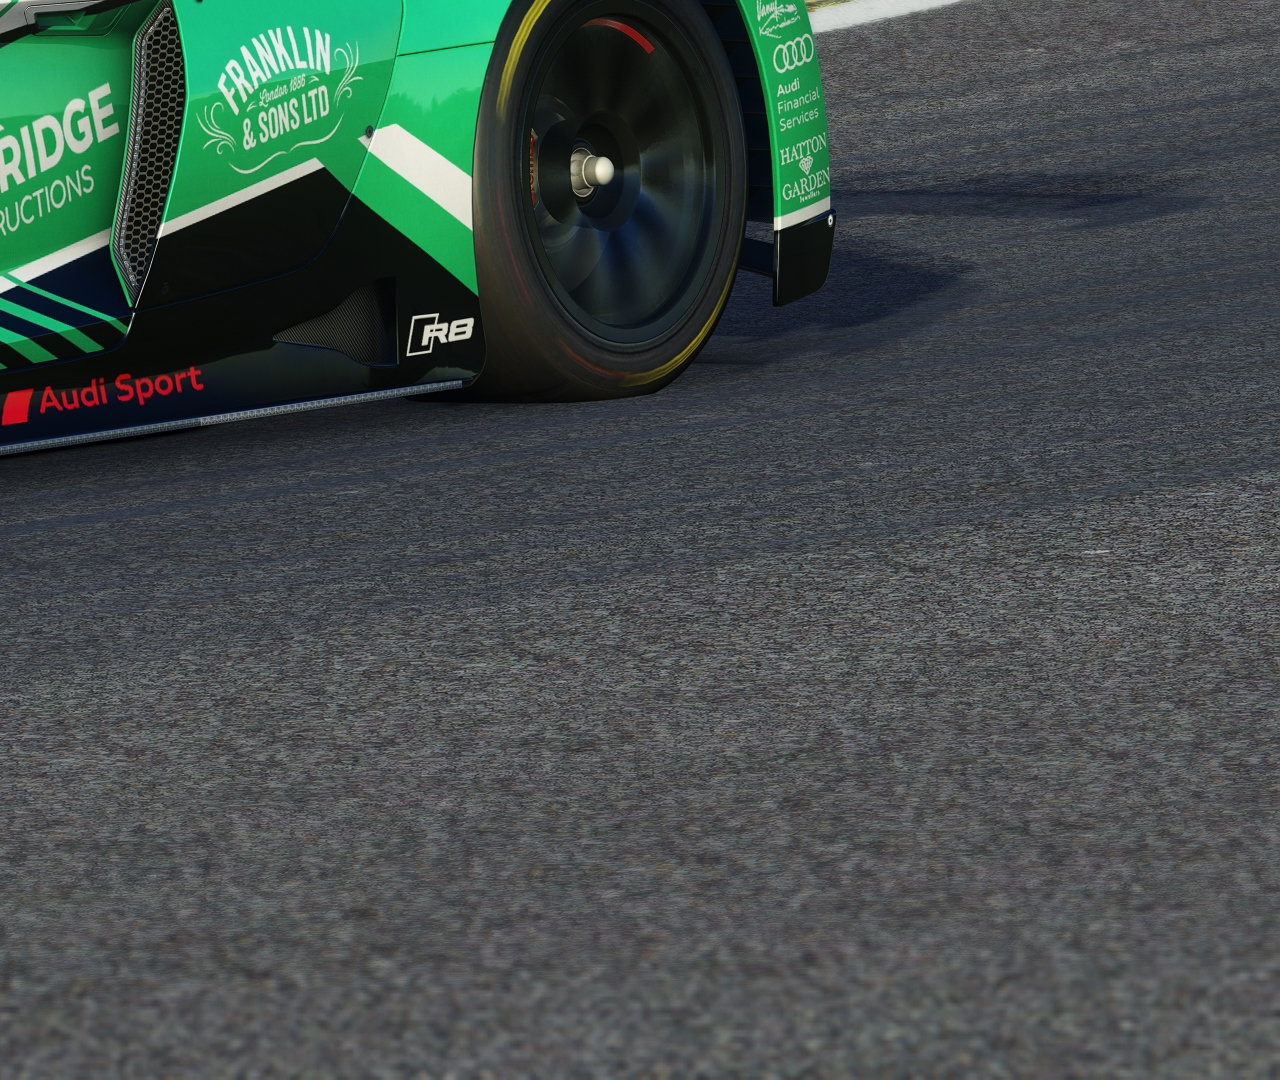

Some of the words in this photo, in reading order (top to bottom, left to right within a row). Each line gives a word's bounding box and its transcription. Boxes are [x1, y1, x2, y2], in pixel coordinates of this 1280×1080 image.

[217, 25, 331, 116] FRANKLIN
[776, 77, 800, 97] Audi
[259, 84, 289, 107] London
[777, 86, 820, 115] Financial
[242, 117, 257, 151] &
[258, 97, 301, 144] SONS
[301, 85, 330, 125] LTD
[779, 108, 819, 132] Services
[779, 132, 827, 166] HATTON
[782, 167, 830, 201] GARDEN
[38, 378, 108, 414] Audi
[113, 365, 204, 408] Sport
